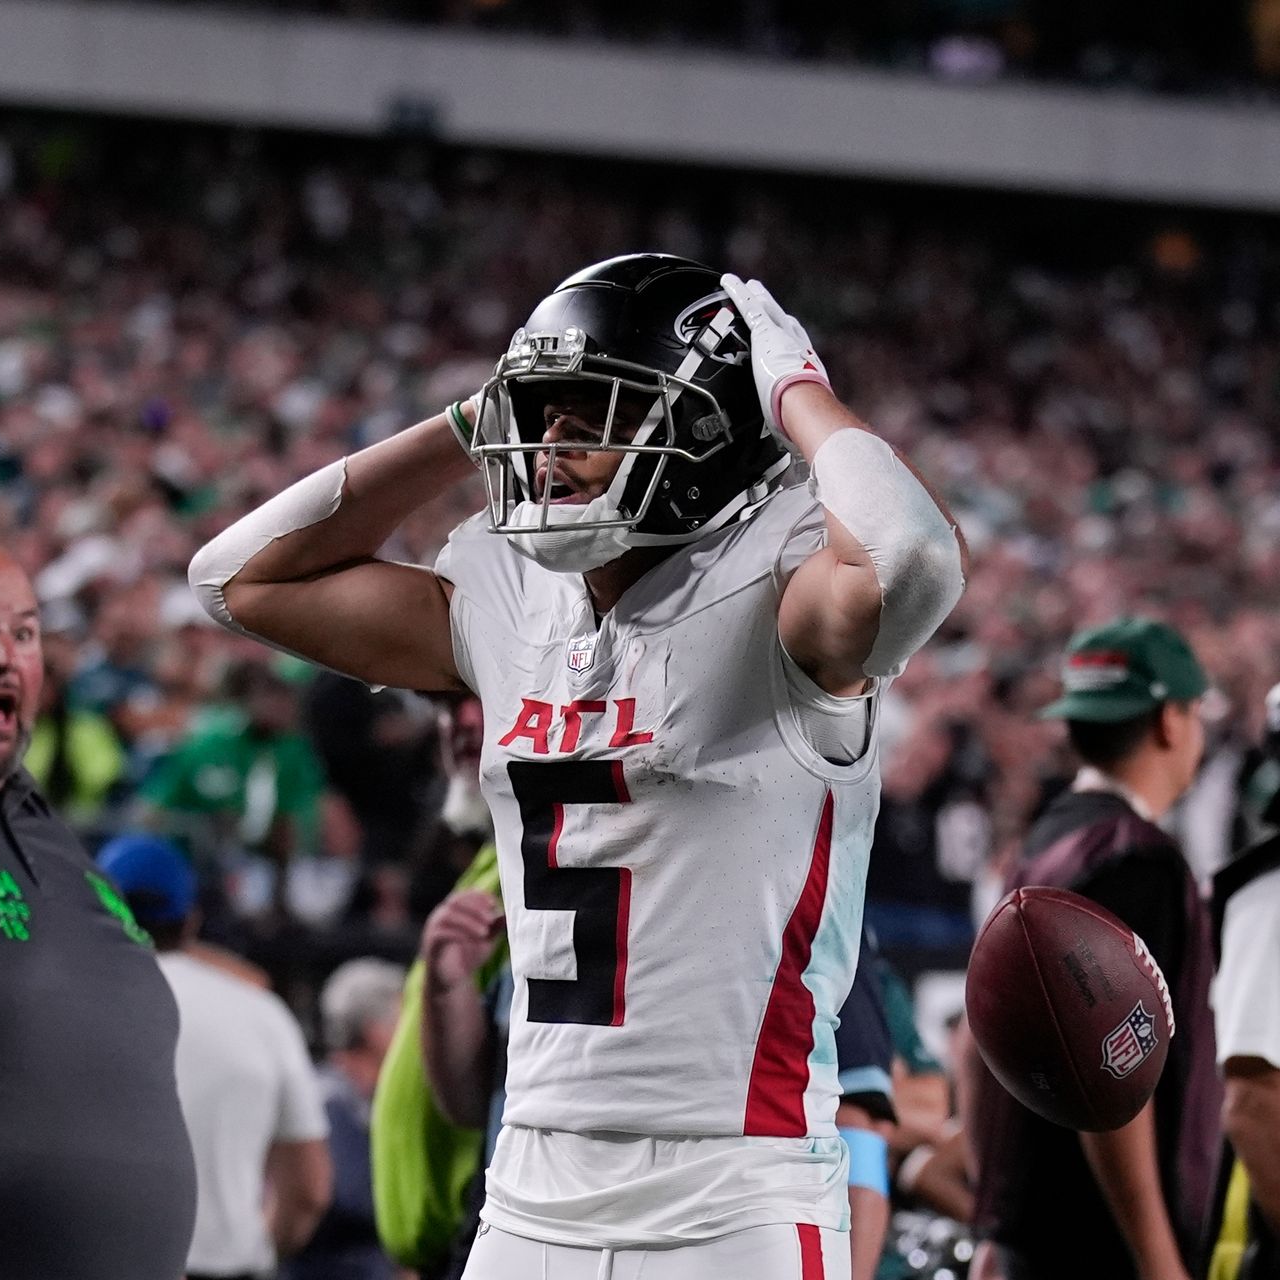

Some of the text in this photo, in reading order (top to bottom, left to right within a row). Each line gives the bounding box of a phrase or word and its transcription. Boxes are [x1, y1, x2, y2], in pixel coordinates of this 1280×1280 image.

[571, 652, 589, 668] NFL
[498, 697, 654, 755] ATL
[506, 759, 633, 1027] 5
[1108, 1028, 1141, 1073] NFL
